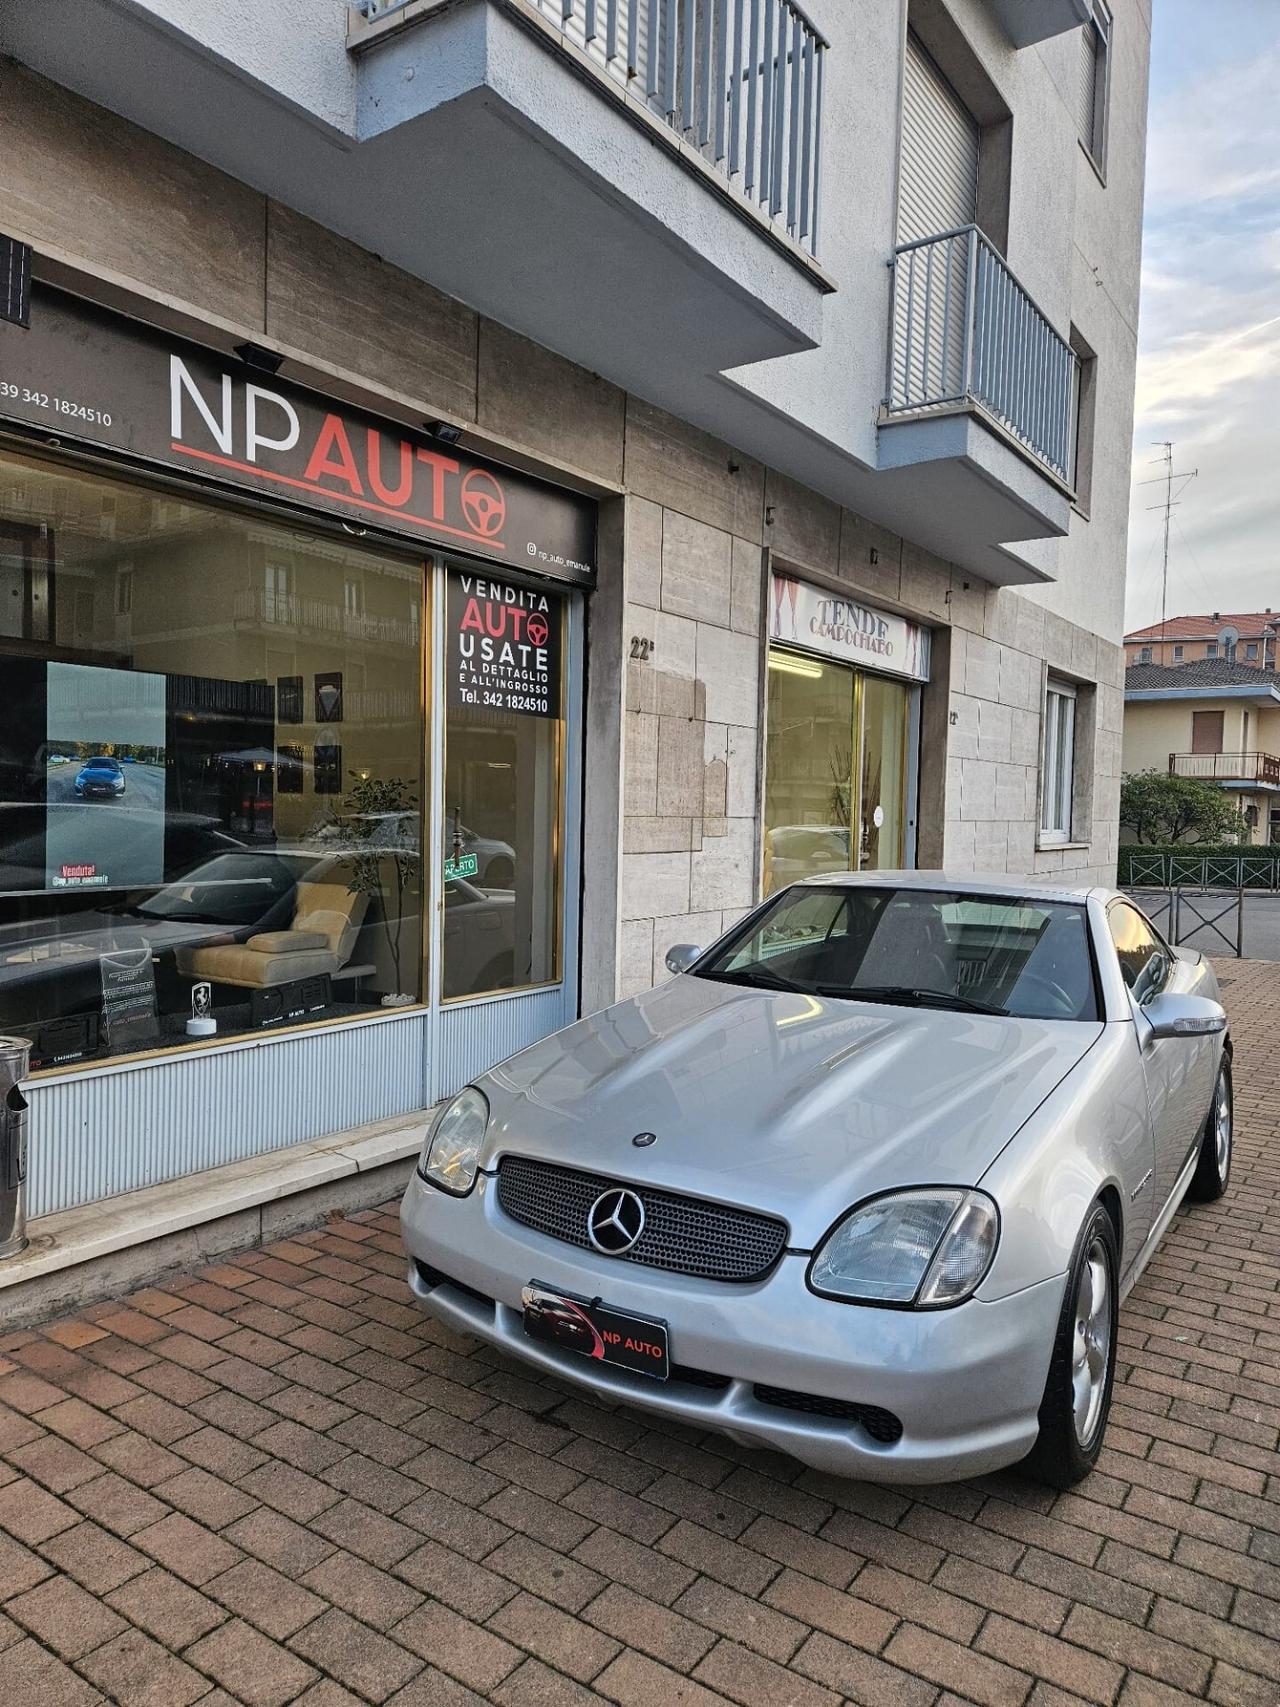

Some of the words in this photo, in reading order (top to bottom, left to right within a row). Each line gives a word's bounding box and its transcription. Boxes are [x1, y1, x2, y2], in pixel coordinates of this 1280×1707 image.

[22, 388, 48, 408] 342
[53, 398, 112, 427] 1824510
[170, 354, 300, 462] NP
[460, 575, 549, 612] VENDITA
[817, 599, 889, 639] TENDE
[459, 633, 548, 671] USATE
[459, 673, 465, 683] E
[471, 675, 548, 695] ALL'INGROSSO
[460, 659, 476, 672] AL
[482, 663, 548, 683] DETTAGLIO
[459, 688, 480, 704] Tel.
[483, 691, 503, 707] 342
[506, 694, 548, 713] 1824510
[602, 1330, 621, 1344] NP
[625, 1338, 662, 1358] AUTO
